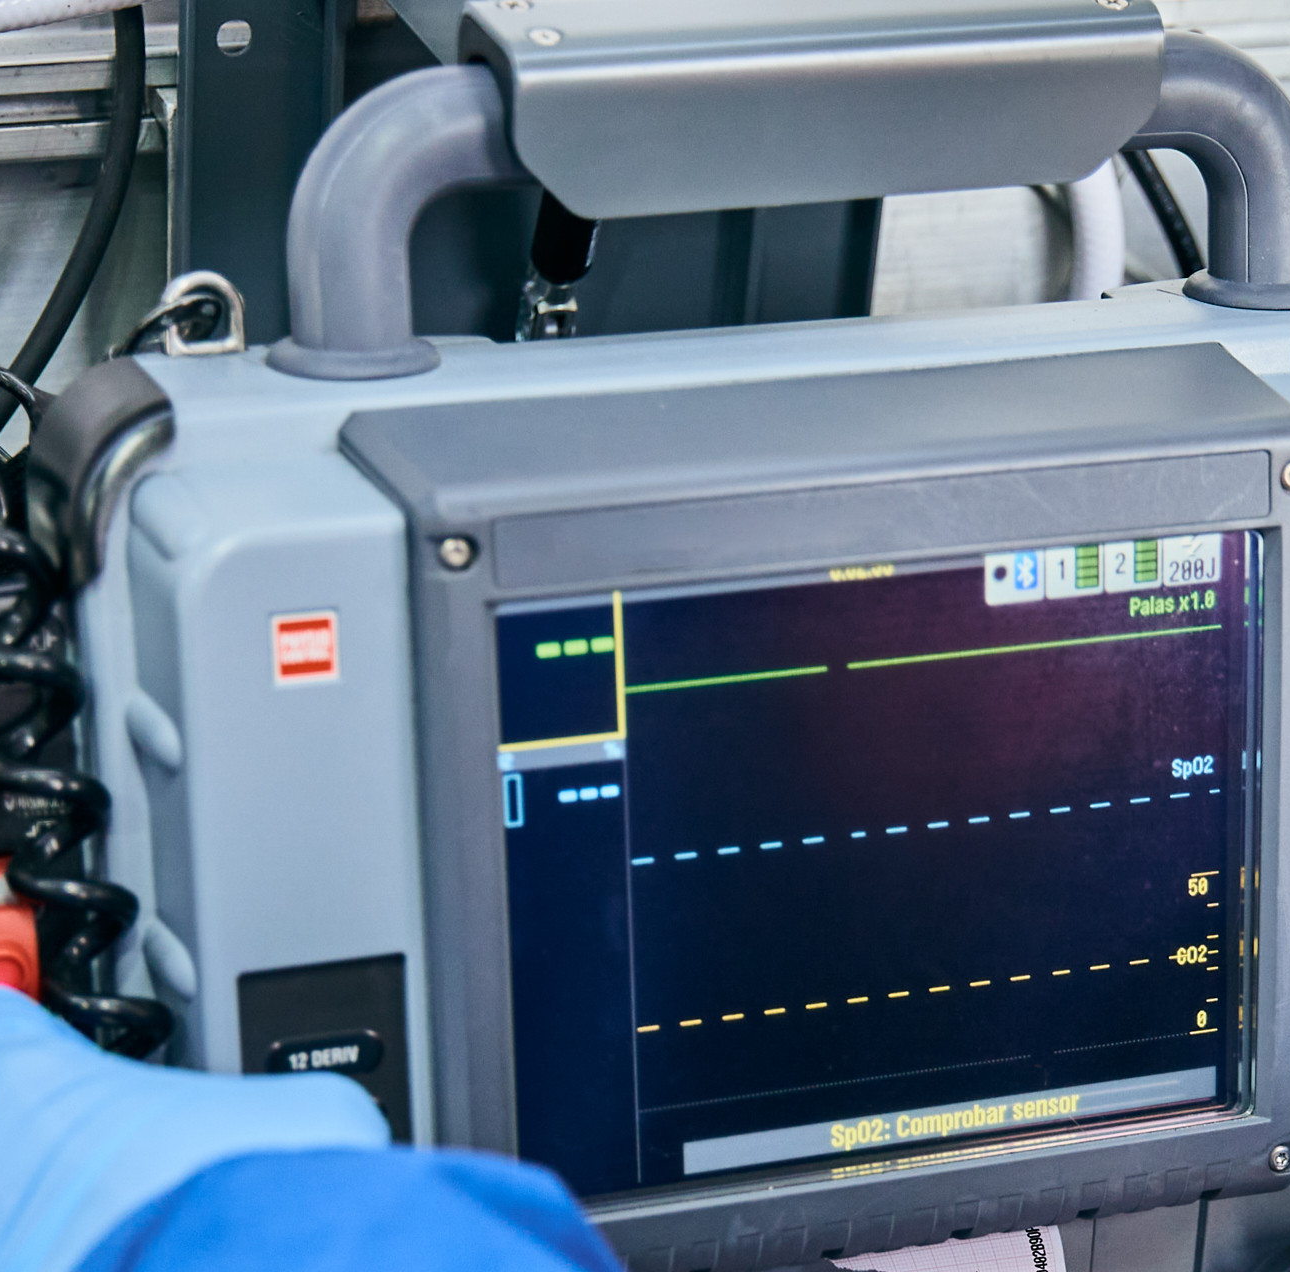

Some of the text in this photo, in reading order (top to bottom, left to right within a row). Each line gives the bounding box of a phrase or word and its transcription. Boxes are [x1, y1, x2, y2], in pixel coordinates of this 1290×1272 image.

[1057, 560, 1067, 580] 1
[1114, 553, 1127, 574] 2
[1129, 589, 1216, 617] Palas x1.0
[1171, 755, 1215, 780] SpO2
[1187, 877, 1208, 896] 50
[1196, 1010, 1207, 1028] 0
[288, 1045, 359, 1070] 12 DERIV
[831, 1095, 1080, 1151] SpO2: Comprobar sensor
